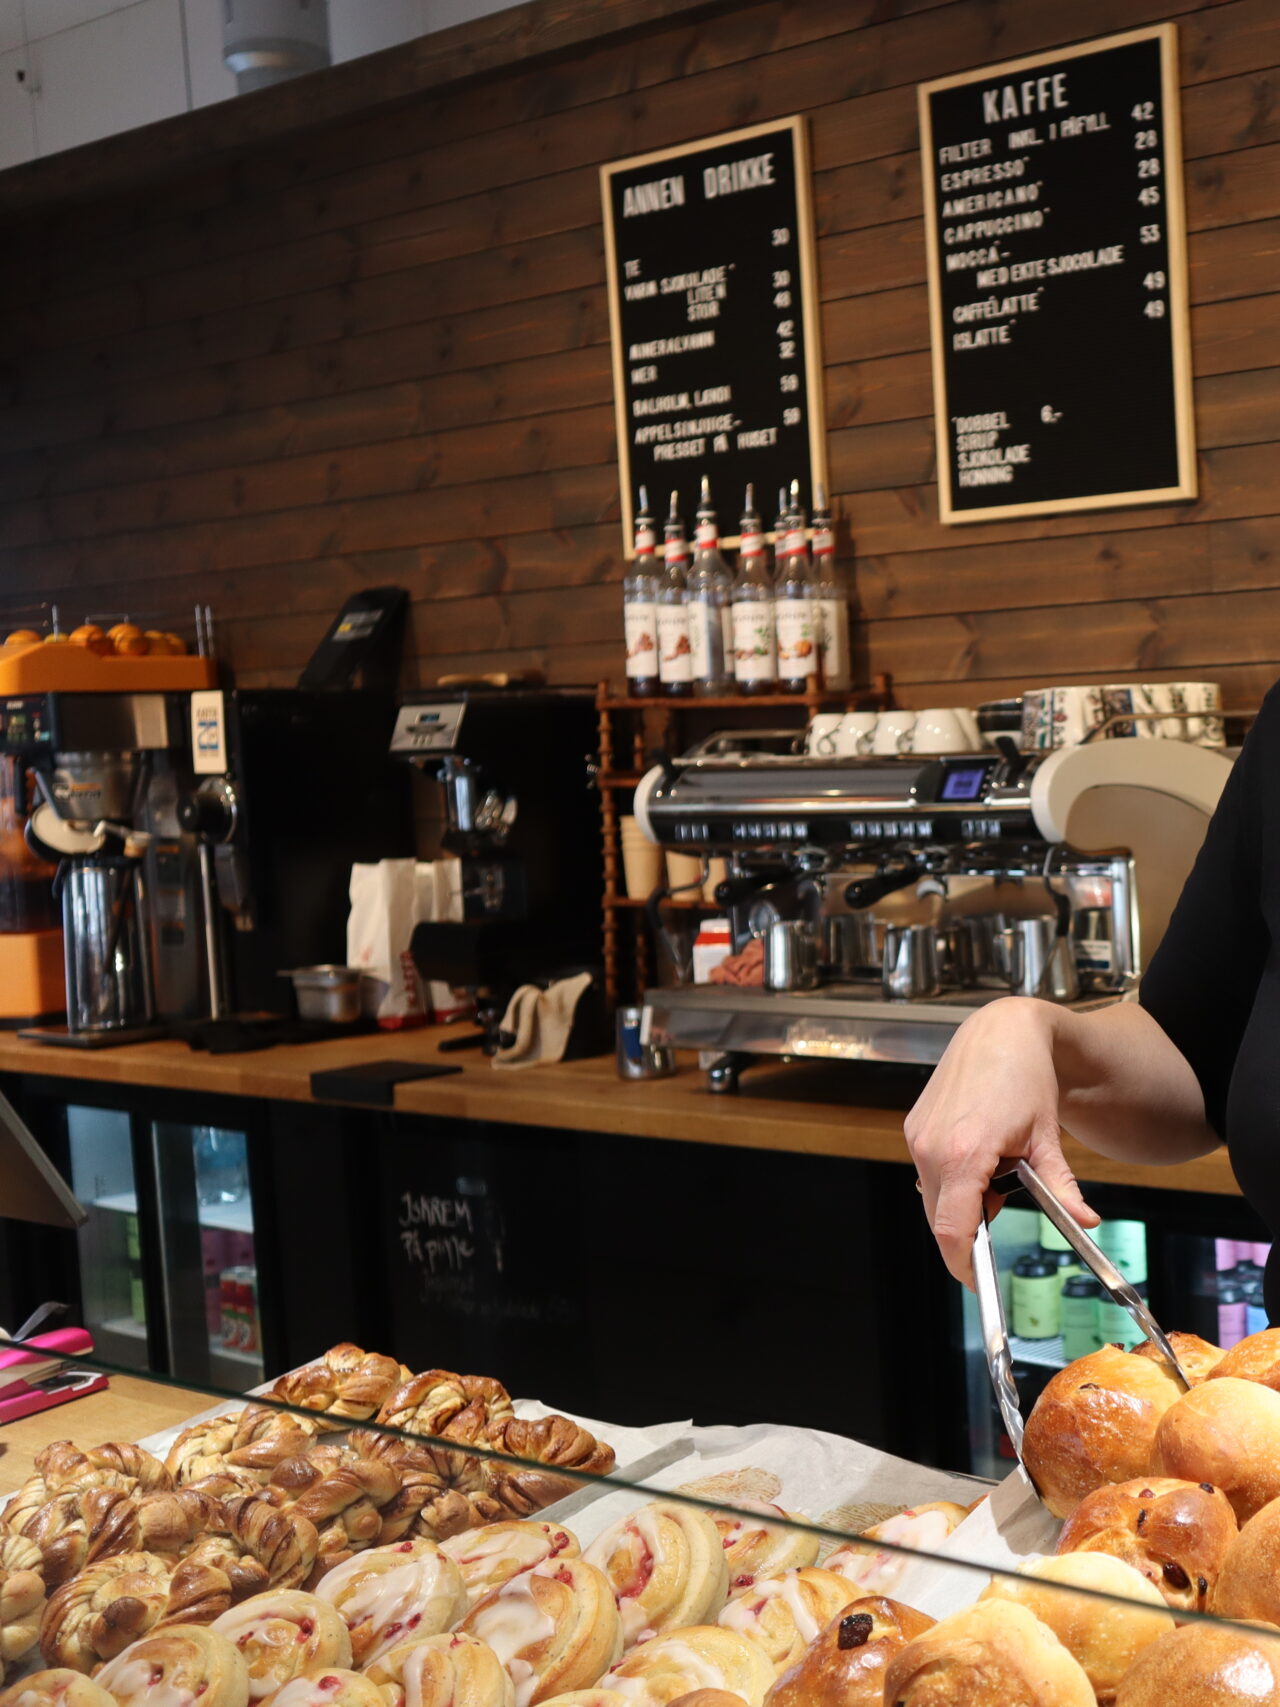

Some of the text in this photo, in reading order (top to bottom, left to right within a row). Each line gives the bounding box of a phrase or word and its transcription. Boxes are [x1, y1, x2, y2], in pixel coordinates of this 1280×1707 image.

[982, 72, 1069, 125] KAFFE
[939, 138, 992, 166] FILTER
[1131, 101, 1154, 121] 42
[623, 152, 776, 219] ANNEN DRIKKE
[1137, 186, 1160, 206] 45
[1139, 224, 1160, 244] 53
[623, 258, 641, 280] TE
[977, 267, 1009, 289] MED
[1011, 259, 1047, 282] EKTE
[1143, 271, 1165, 290] 49
[686, 282, 727, 305] LITEN
[686, 301, 720, 322] STOR
[1143, 299, 1165, 319] 49
